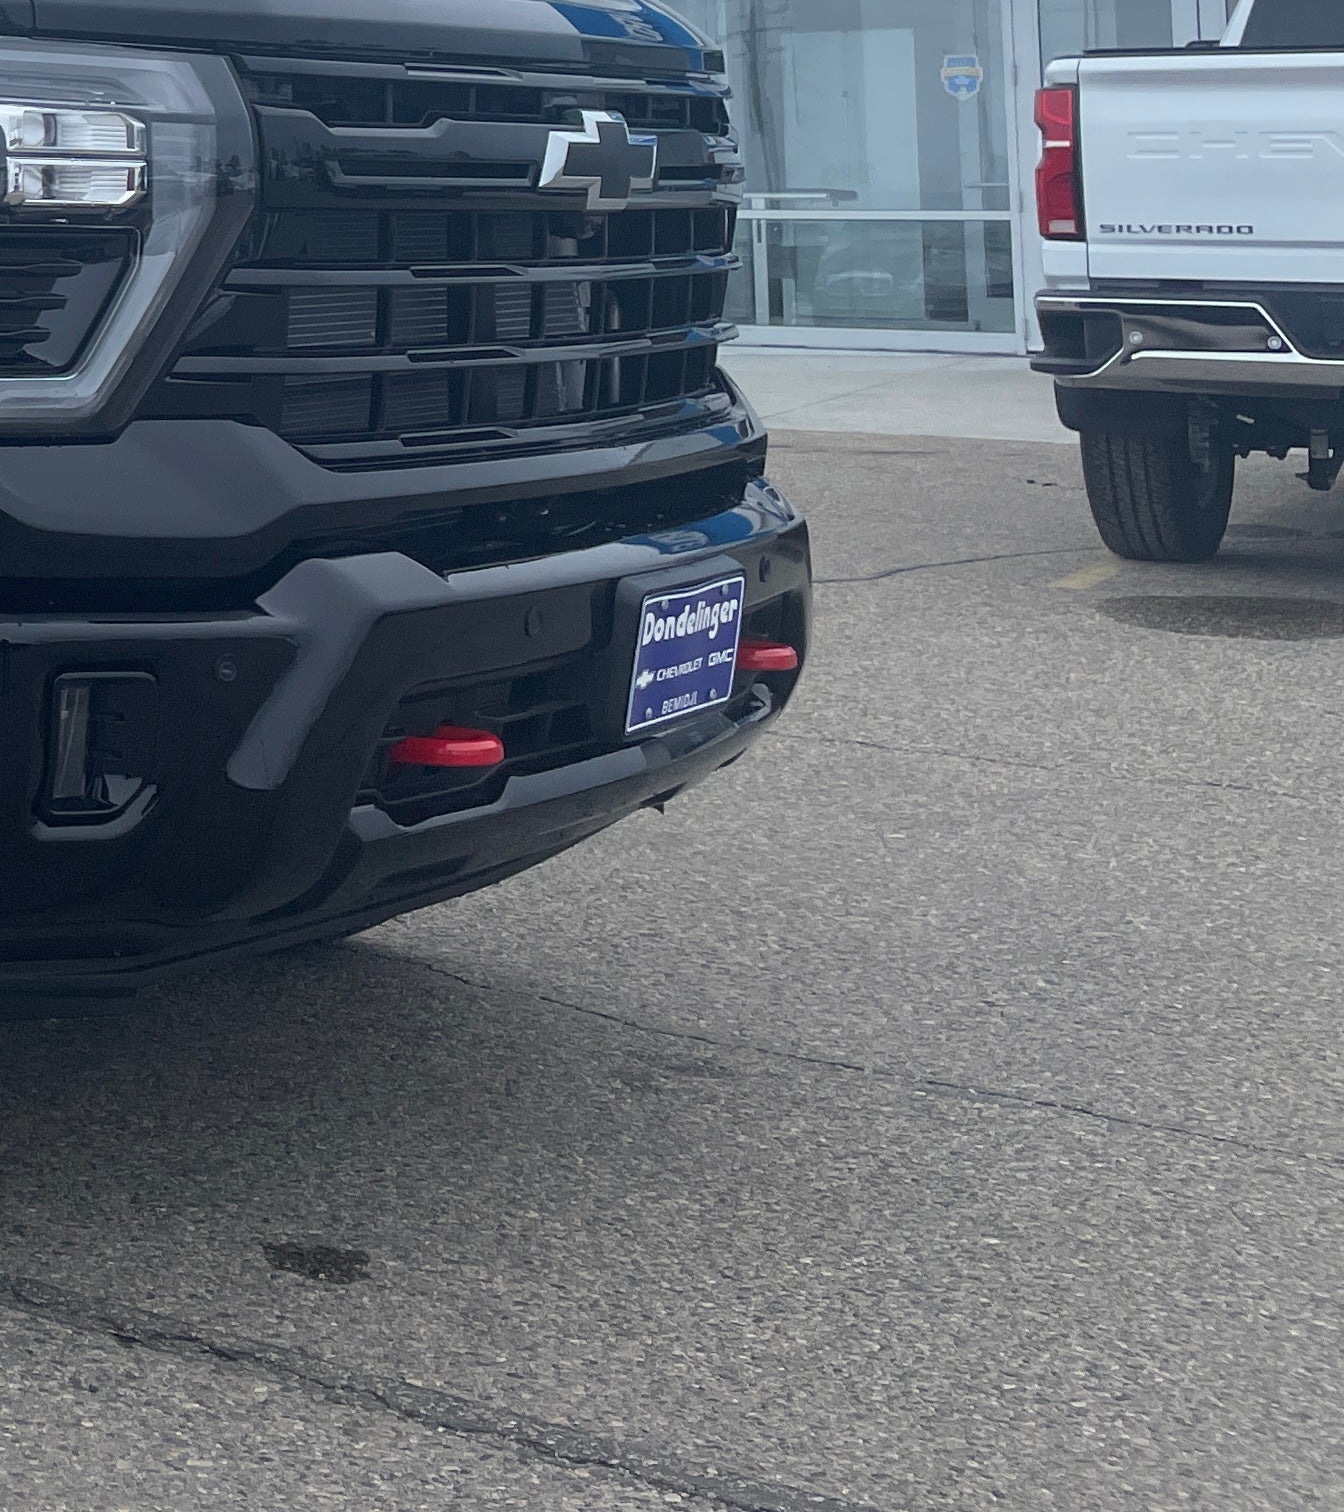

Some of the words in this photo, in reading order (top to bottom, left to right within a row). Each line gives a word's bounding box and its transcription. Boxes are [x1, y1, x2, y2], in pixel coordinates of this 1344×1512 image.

[1099, 223, 1254, 236] SILVERADO
[641, 598, 739, 646] Dondelinger
[656, 656, 704, 682] CHEVROLET
[707, 648, 735, 668] GMC
[661, 690, 698, 715] BEMIDJI
